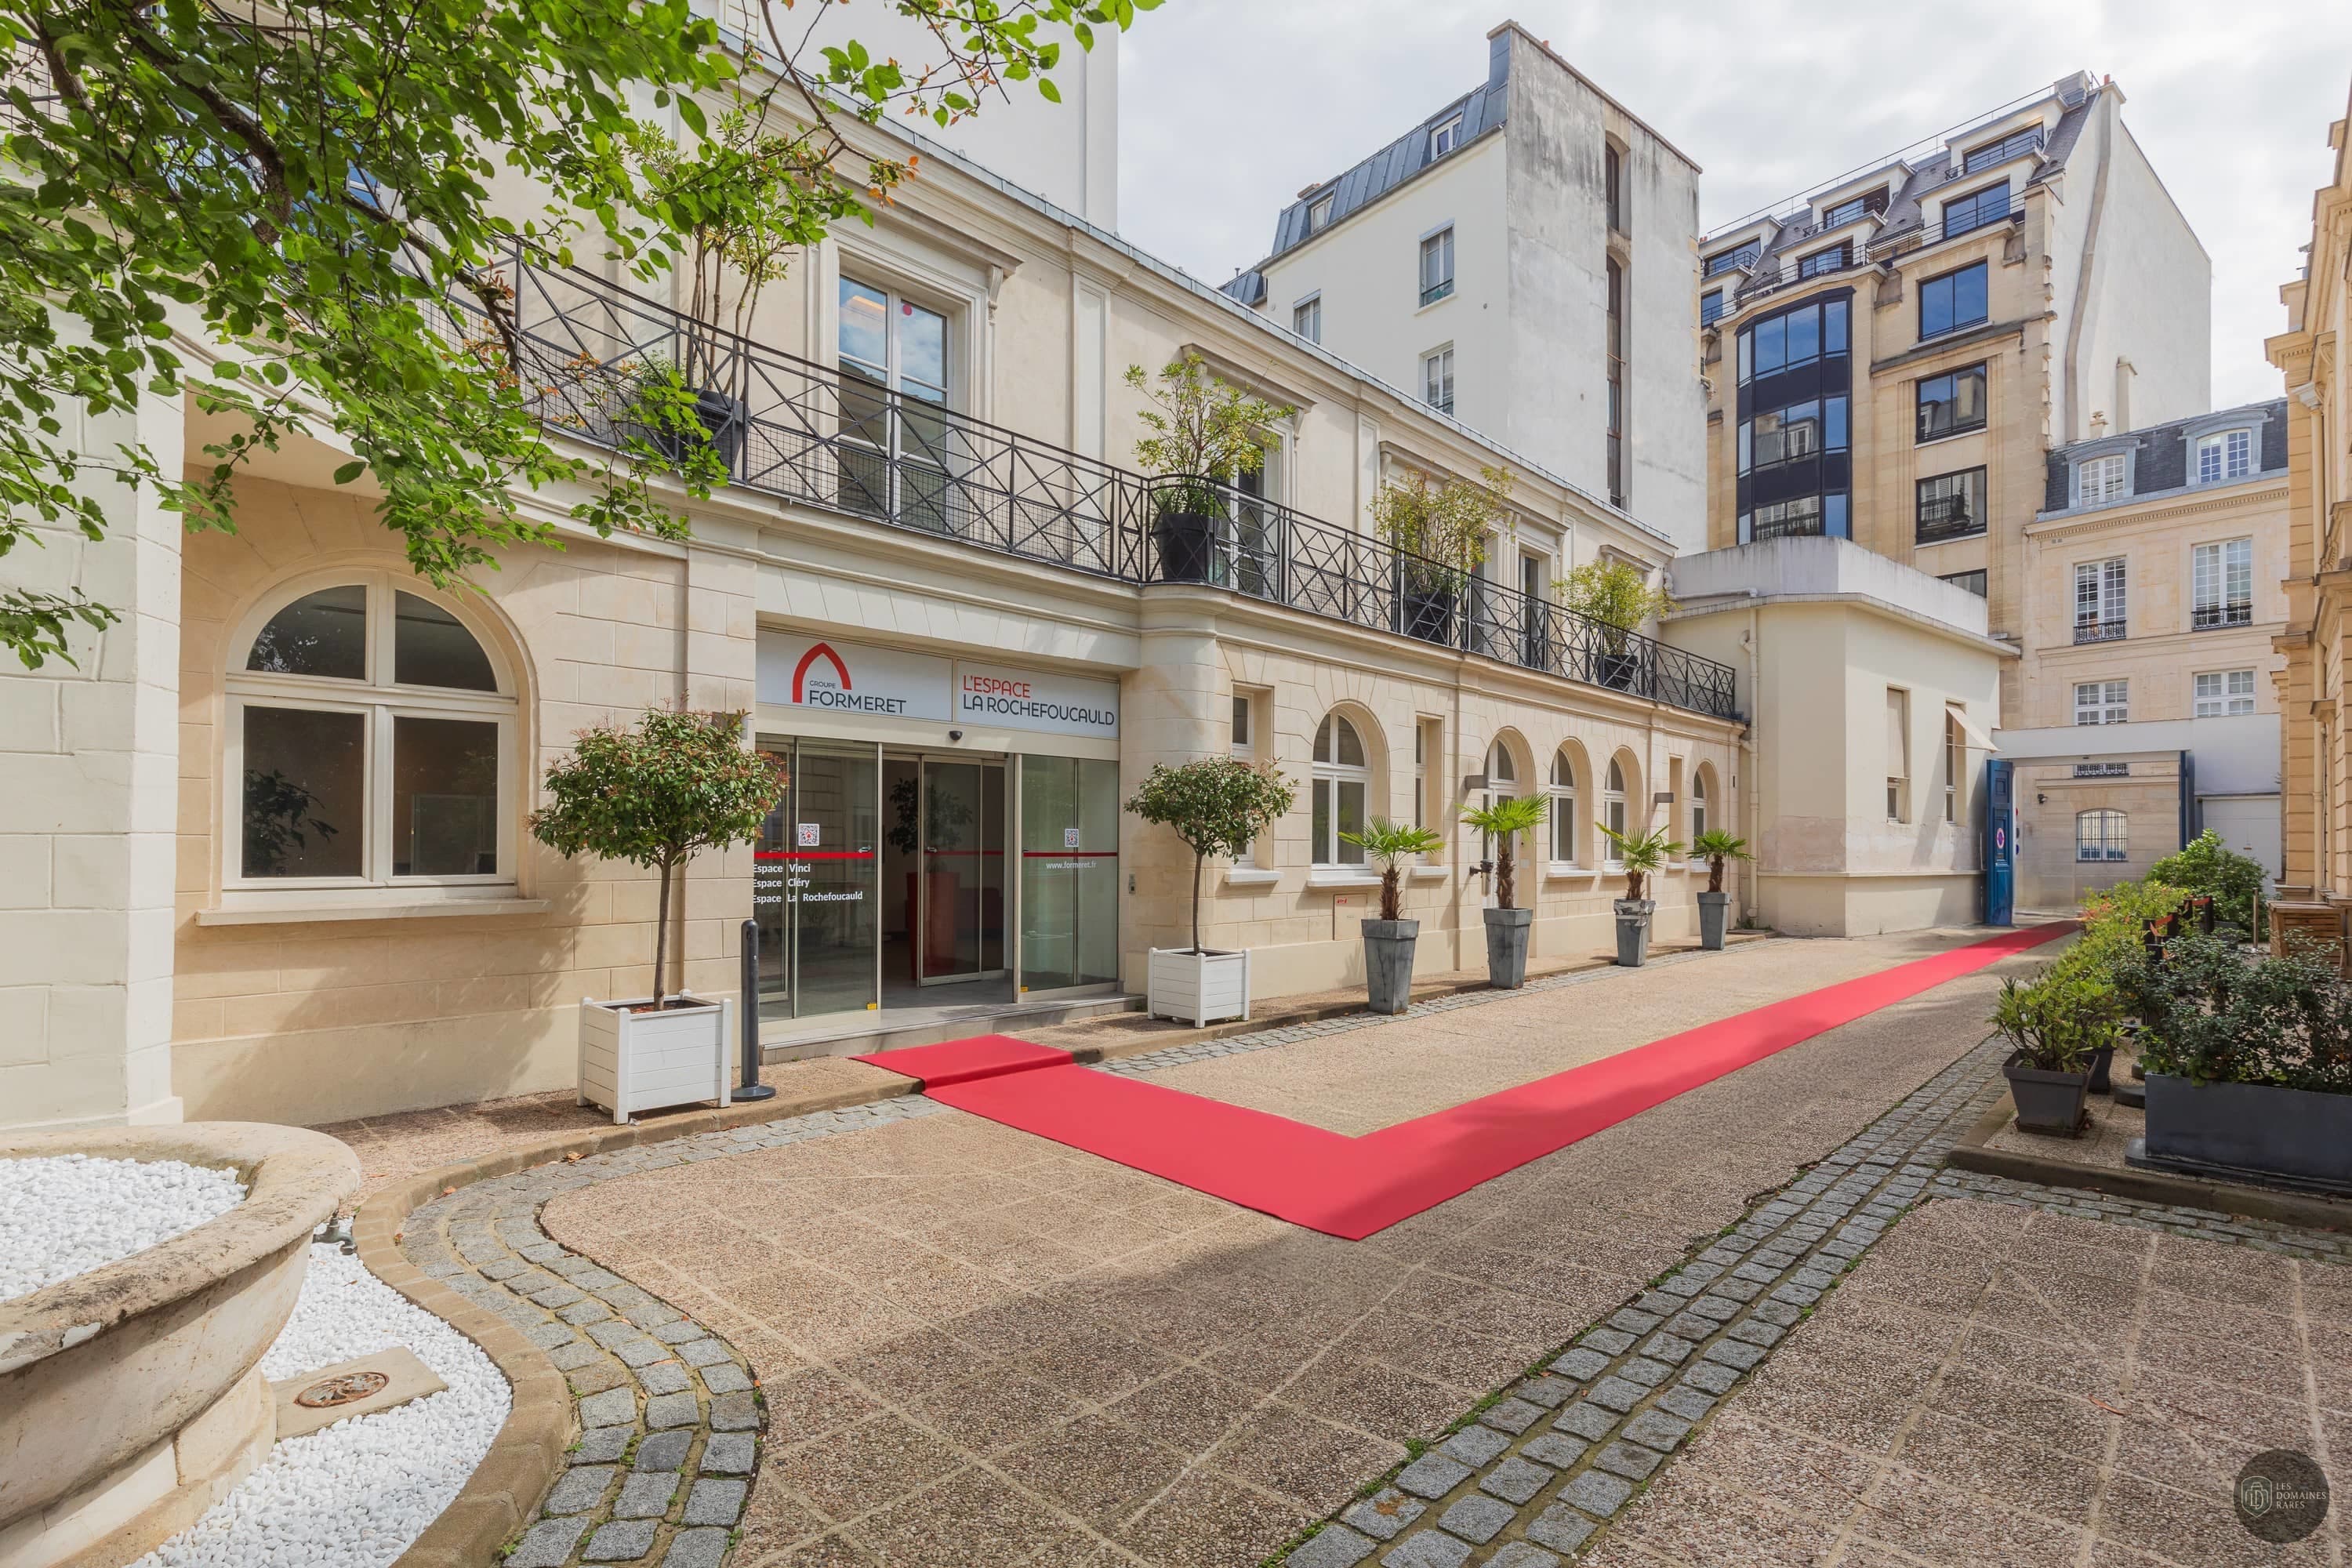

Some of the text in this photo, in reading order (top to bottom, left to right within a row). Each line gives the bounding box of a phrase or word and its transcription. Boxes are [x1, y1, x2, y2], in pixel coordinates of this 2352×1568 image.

[809, 680, 837, 689] GROUPE
[964, 675, 1031, 699] L'ESPACE
[809, 690, 906, 713] FORMERET
[964, 694, 1115, 725] LA ROCHEFOUCAULD
[753, 863, 811, 874] Espace Vinci
[1046, 861, 1096, 869] www.formeret.fr
[753, 878, 810, 889] Espace Cléry
[787, 894, 797, 902] La
[803, 891, 863, 902] Rochefoucauld
